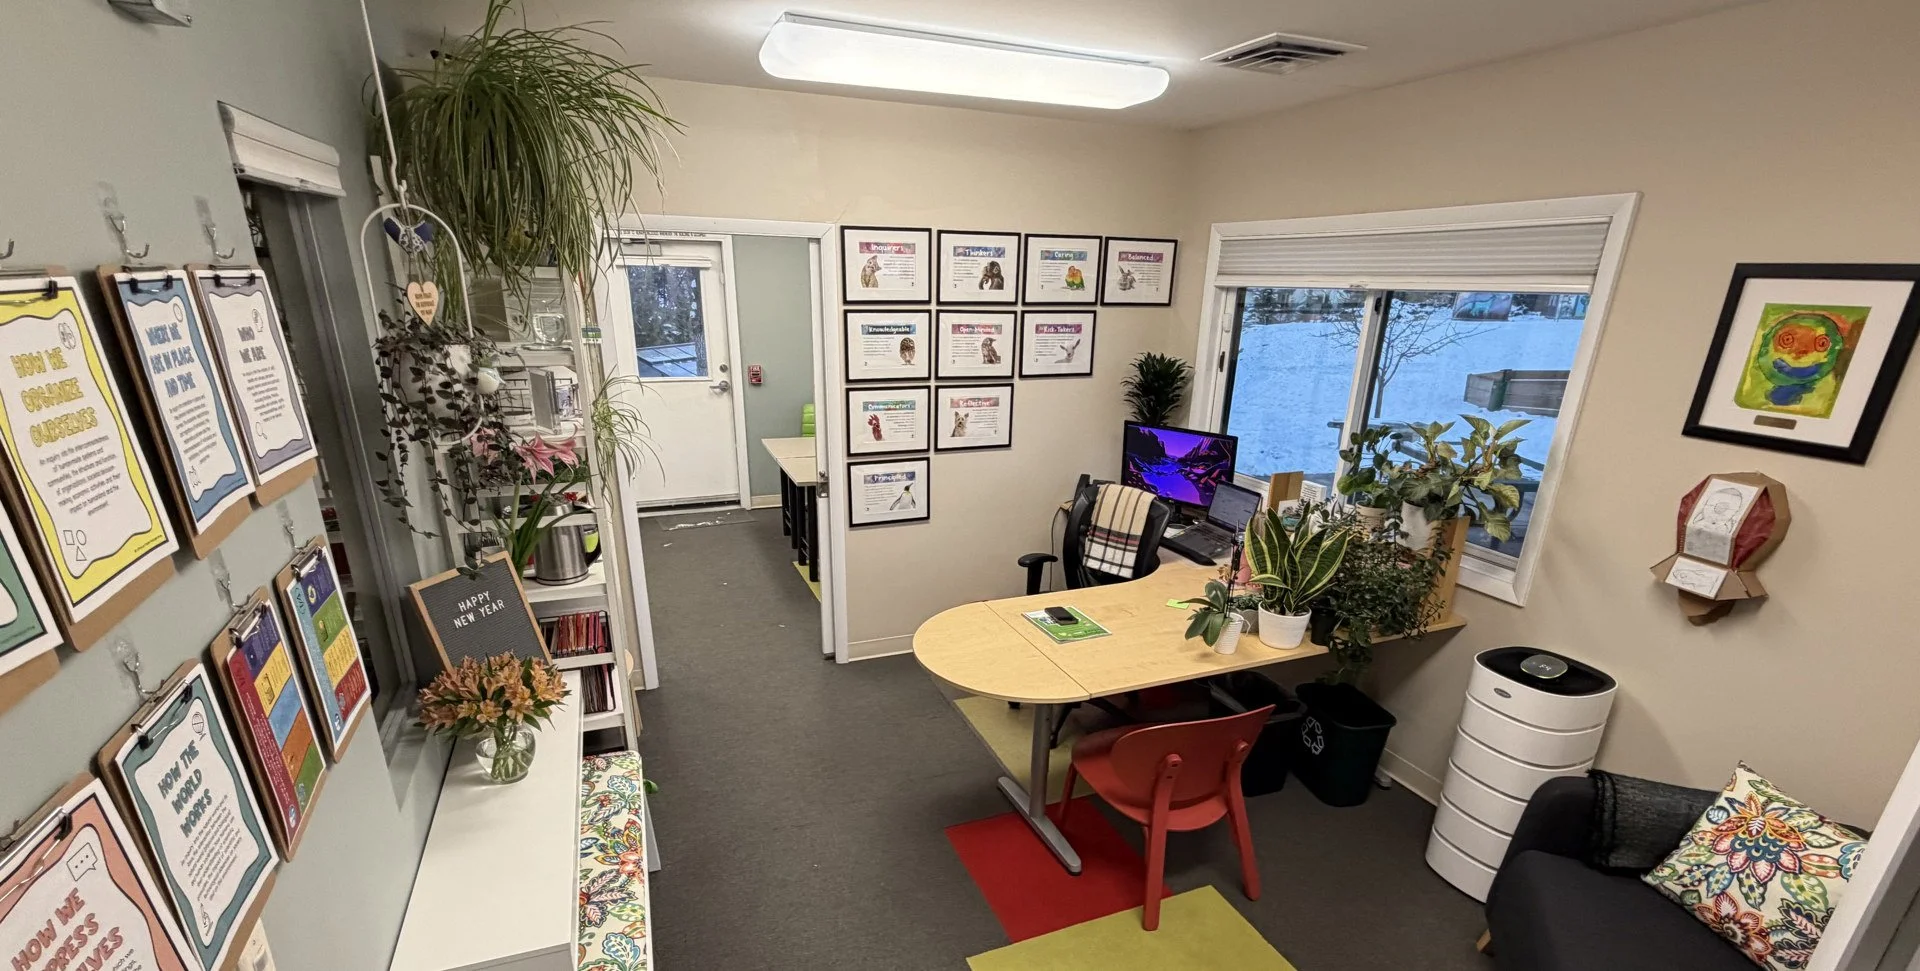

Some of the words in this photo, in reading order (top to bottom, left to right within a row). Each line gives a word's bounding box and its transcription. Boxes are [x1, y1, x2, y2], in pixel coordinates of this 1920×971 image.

[1054, 251, 1074, 260] Caring
[1128, 253, 1154, 261] Balanced
[10, 350, 47, 378] HOW
[45, 346, 68, 370] WE
[21, 377, 84, 412] ORGANIZE
[30, 406, 98, 447] OURSELVES
[453, 612, 476, 629] NEW
[478, 599, 505, 617] YEAR
[458, 591, 490, 612] HAPPY
[157, 761, 182, 799] HOW
[180, 740, 200, 769] THE
[172, 769, 202, 815] WORLD
[180, 788, 213, 838] WORKS
[11, 919, 57, 971] HOW
[55, 887, 85, 926] WE
[42, 913, 99, 971] PRESS
